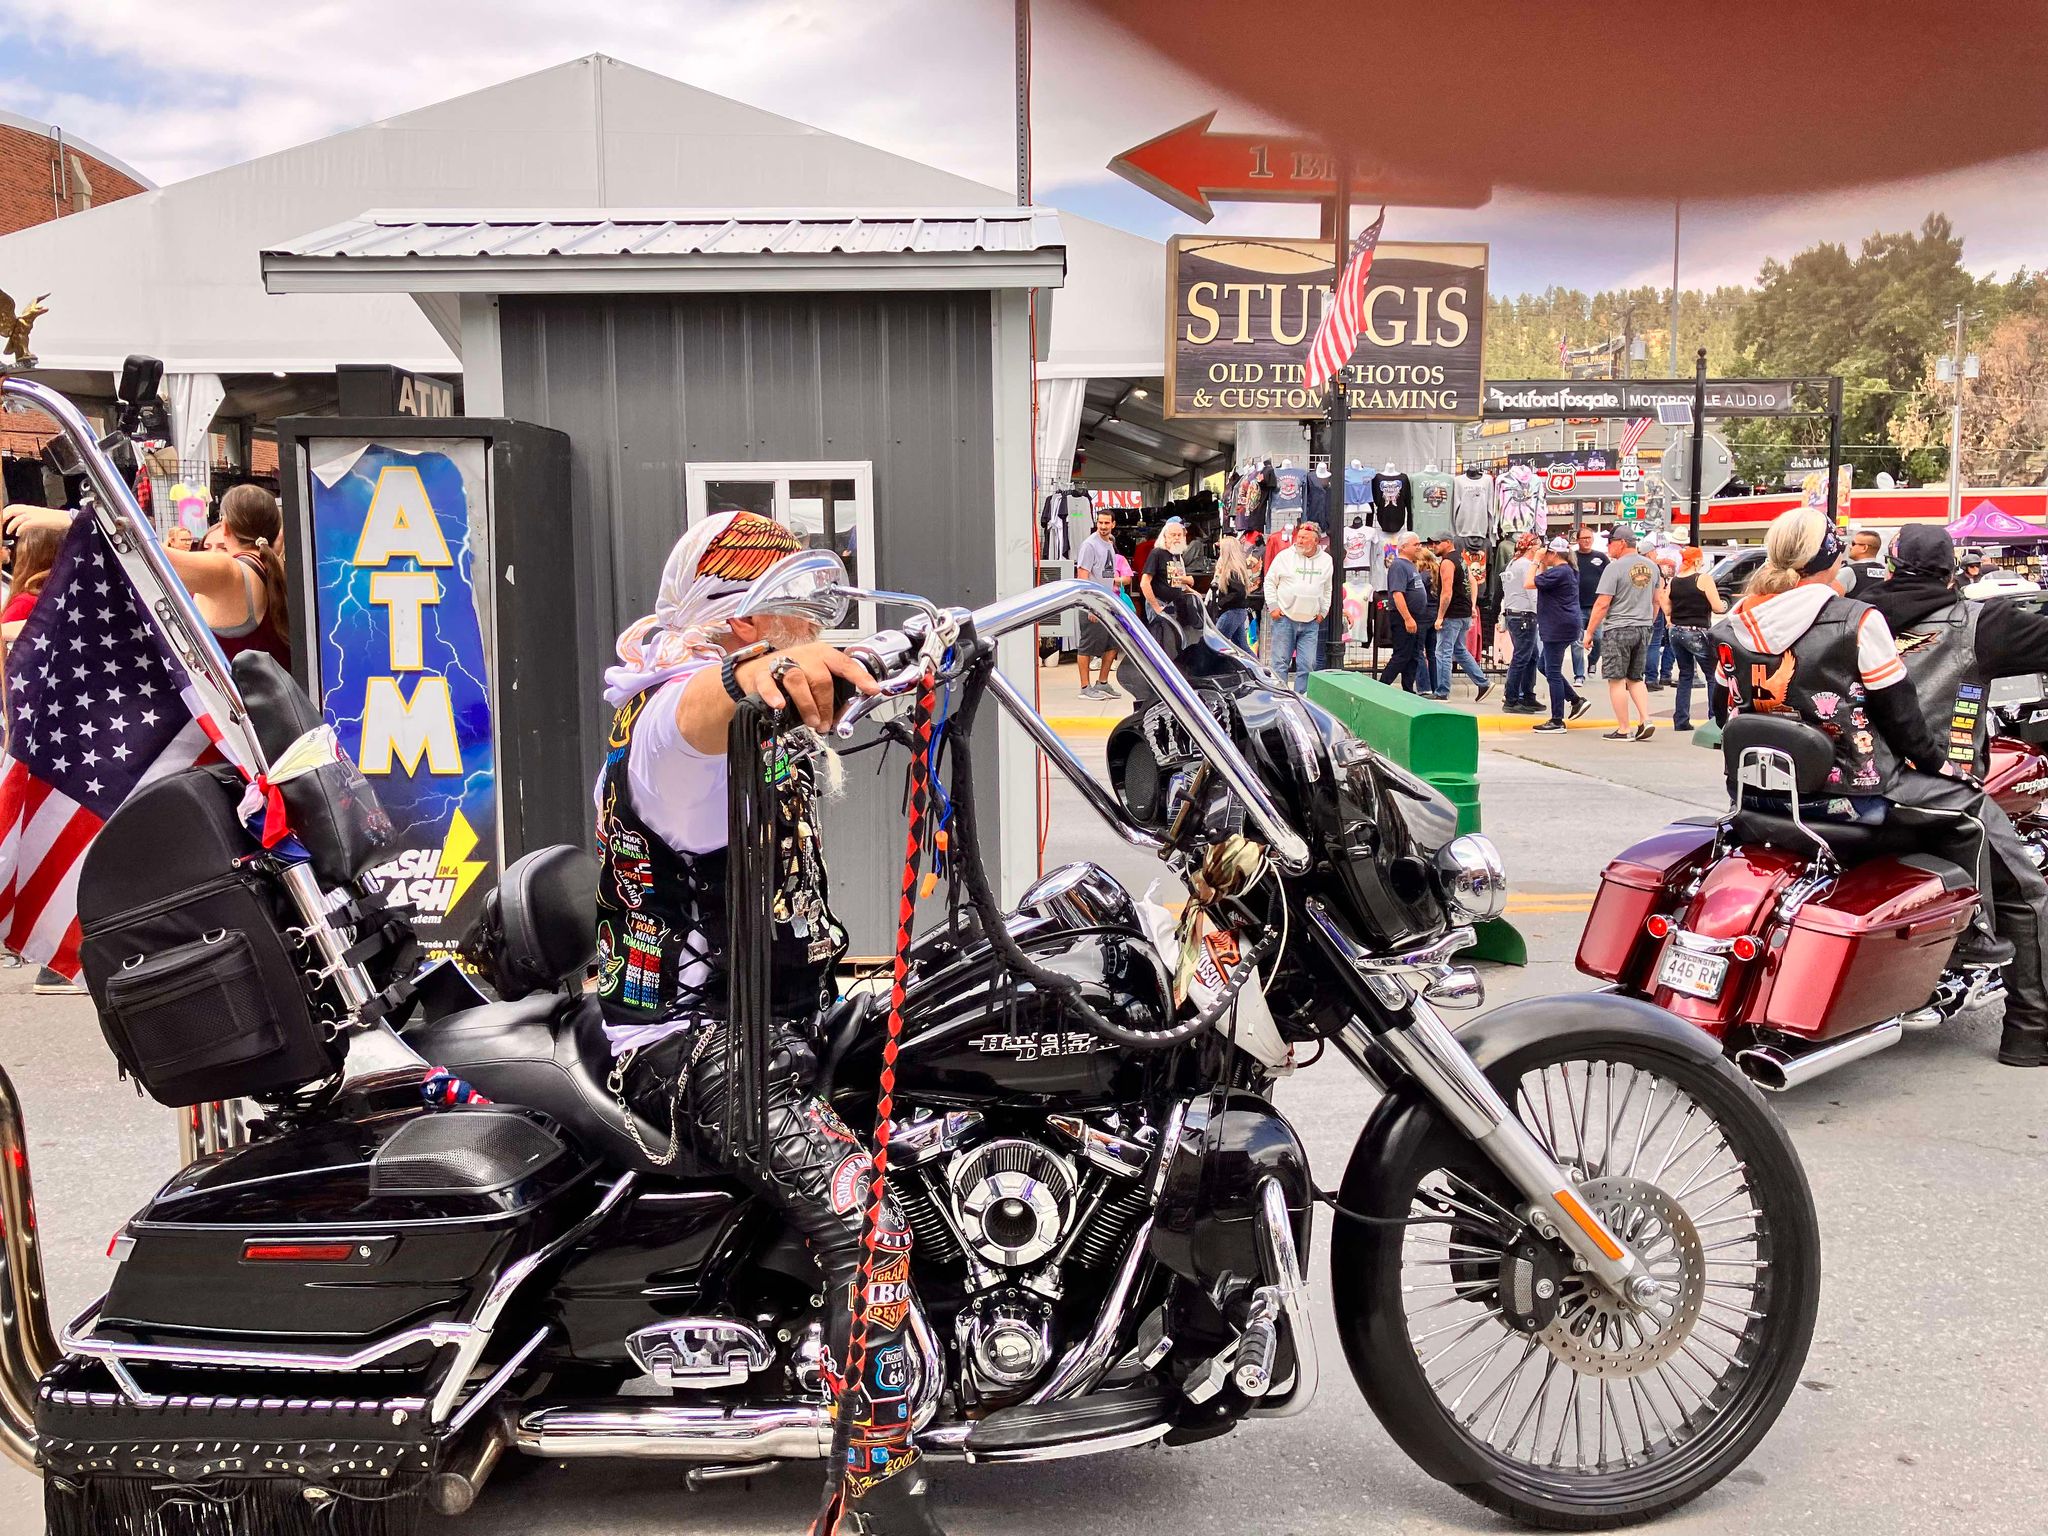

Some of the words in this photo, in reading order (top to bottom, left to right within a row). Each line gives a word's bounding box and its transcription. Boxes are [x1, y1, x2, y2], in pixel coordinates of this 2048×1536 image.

[1249, 144, 1273, 178] 1
[1186, 281, 1469, 348] STUGIS
[1209, 363, 1263, 384] OLD
[399, 376, 452, 417] ATM
[1193, 389, 1213, 409] &
[1724, 394, 1776, 407] AUDIO
[1552, 476, 1571, 487] 66
[1868, 569, 1885, 577] POLIC
[353, 466, 463, 778] ATM
[622, 833, 642, 845] RODE
[370, 849, 442, 878] ASH
[634, 929, 658, 945] MINE
[635, 921, 657, 935] RODE
[622, 933, 663, 958] TOMAHAWK
[1672, 949, 1718, 968] WISCONSIN
[1668, 960, 1695, 978] 446
[1698, 967, 1720, 986] RM
[889, 1369, 904, 1385] 66
